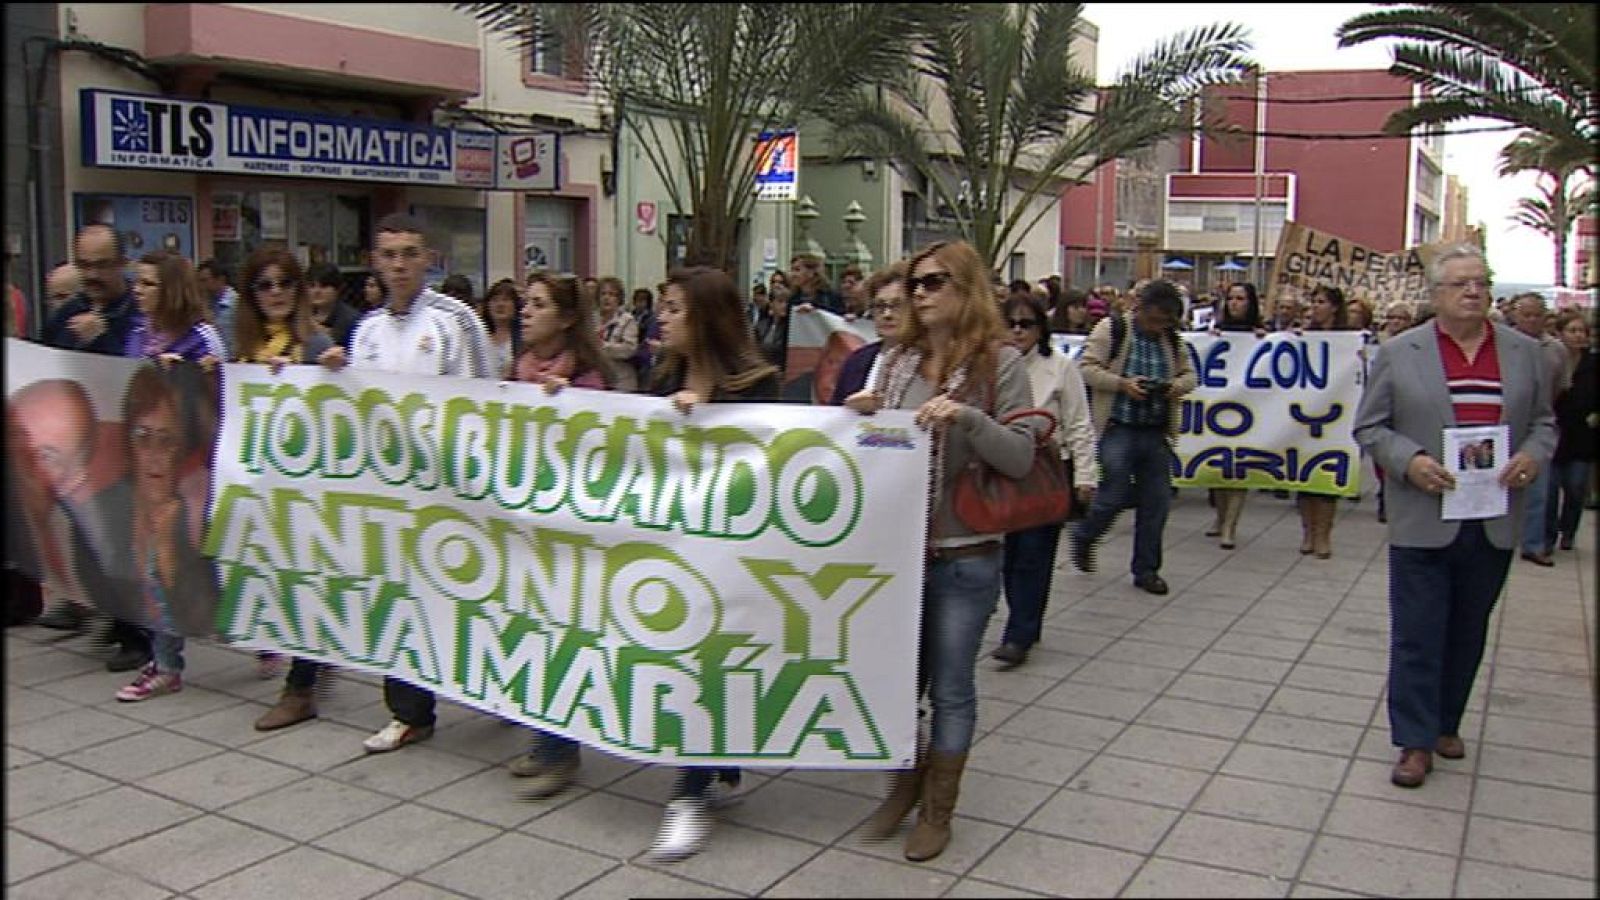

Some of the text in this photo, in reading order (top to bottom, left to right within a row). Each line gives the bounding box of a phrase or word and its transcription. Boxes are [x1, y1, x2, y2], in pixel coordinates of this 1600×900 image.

[145, 103, 214, 158] TLS
[231, 115, 450, 168] INFORMATICA
[111, 154, 214, 168] INFORMATICA
[1305, 231, 1341, 263] LA
[1244, 340, 1329, 389] CON
[1288, 402, 1343, 438] Y
[238, 383, 864, 547] TODOS BUSCANDO
[203, 484, 895, 664] ANTONIO Y
[214, 563, 891, 760] ANA MARÍA
